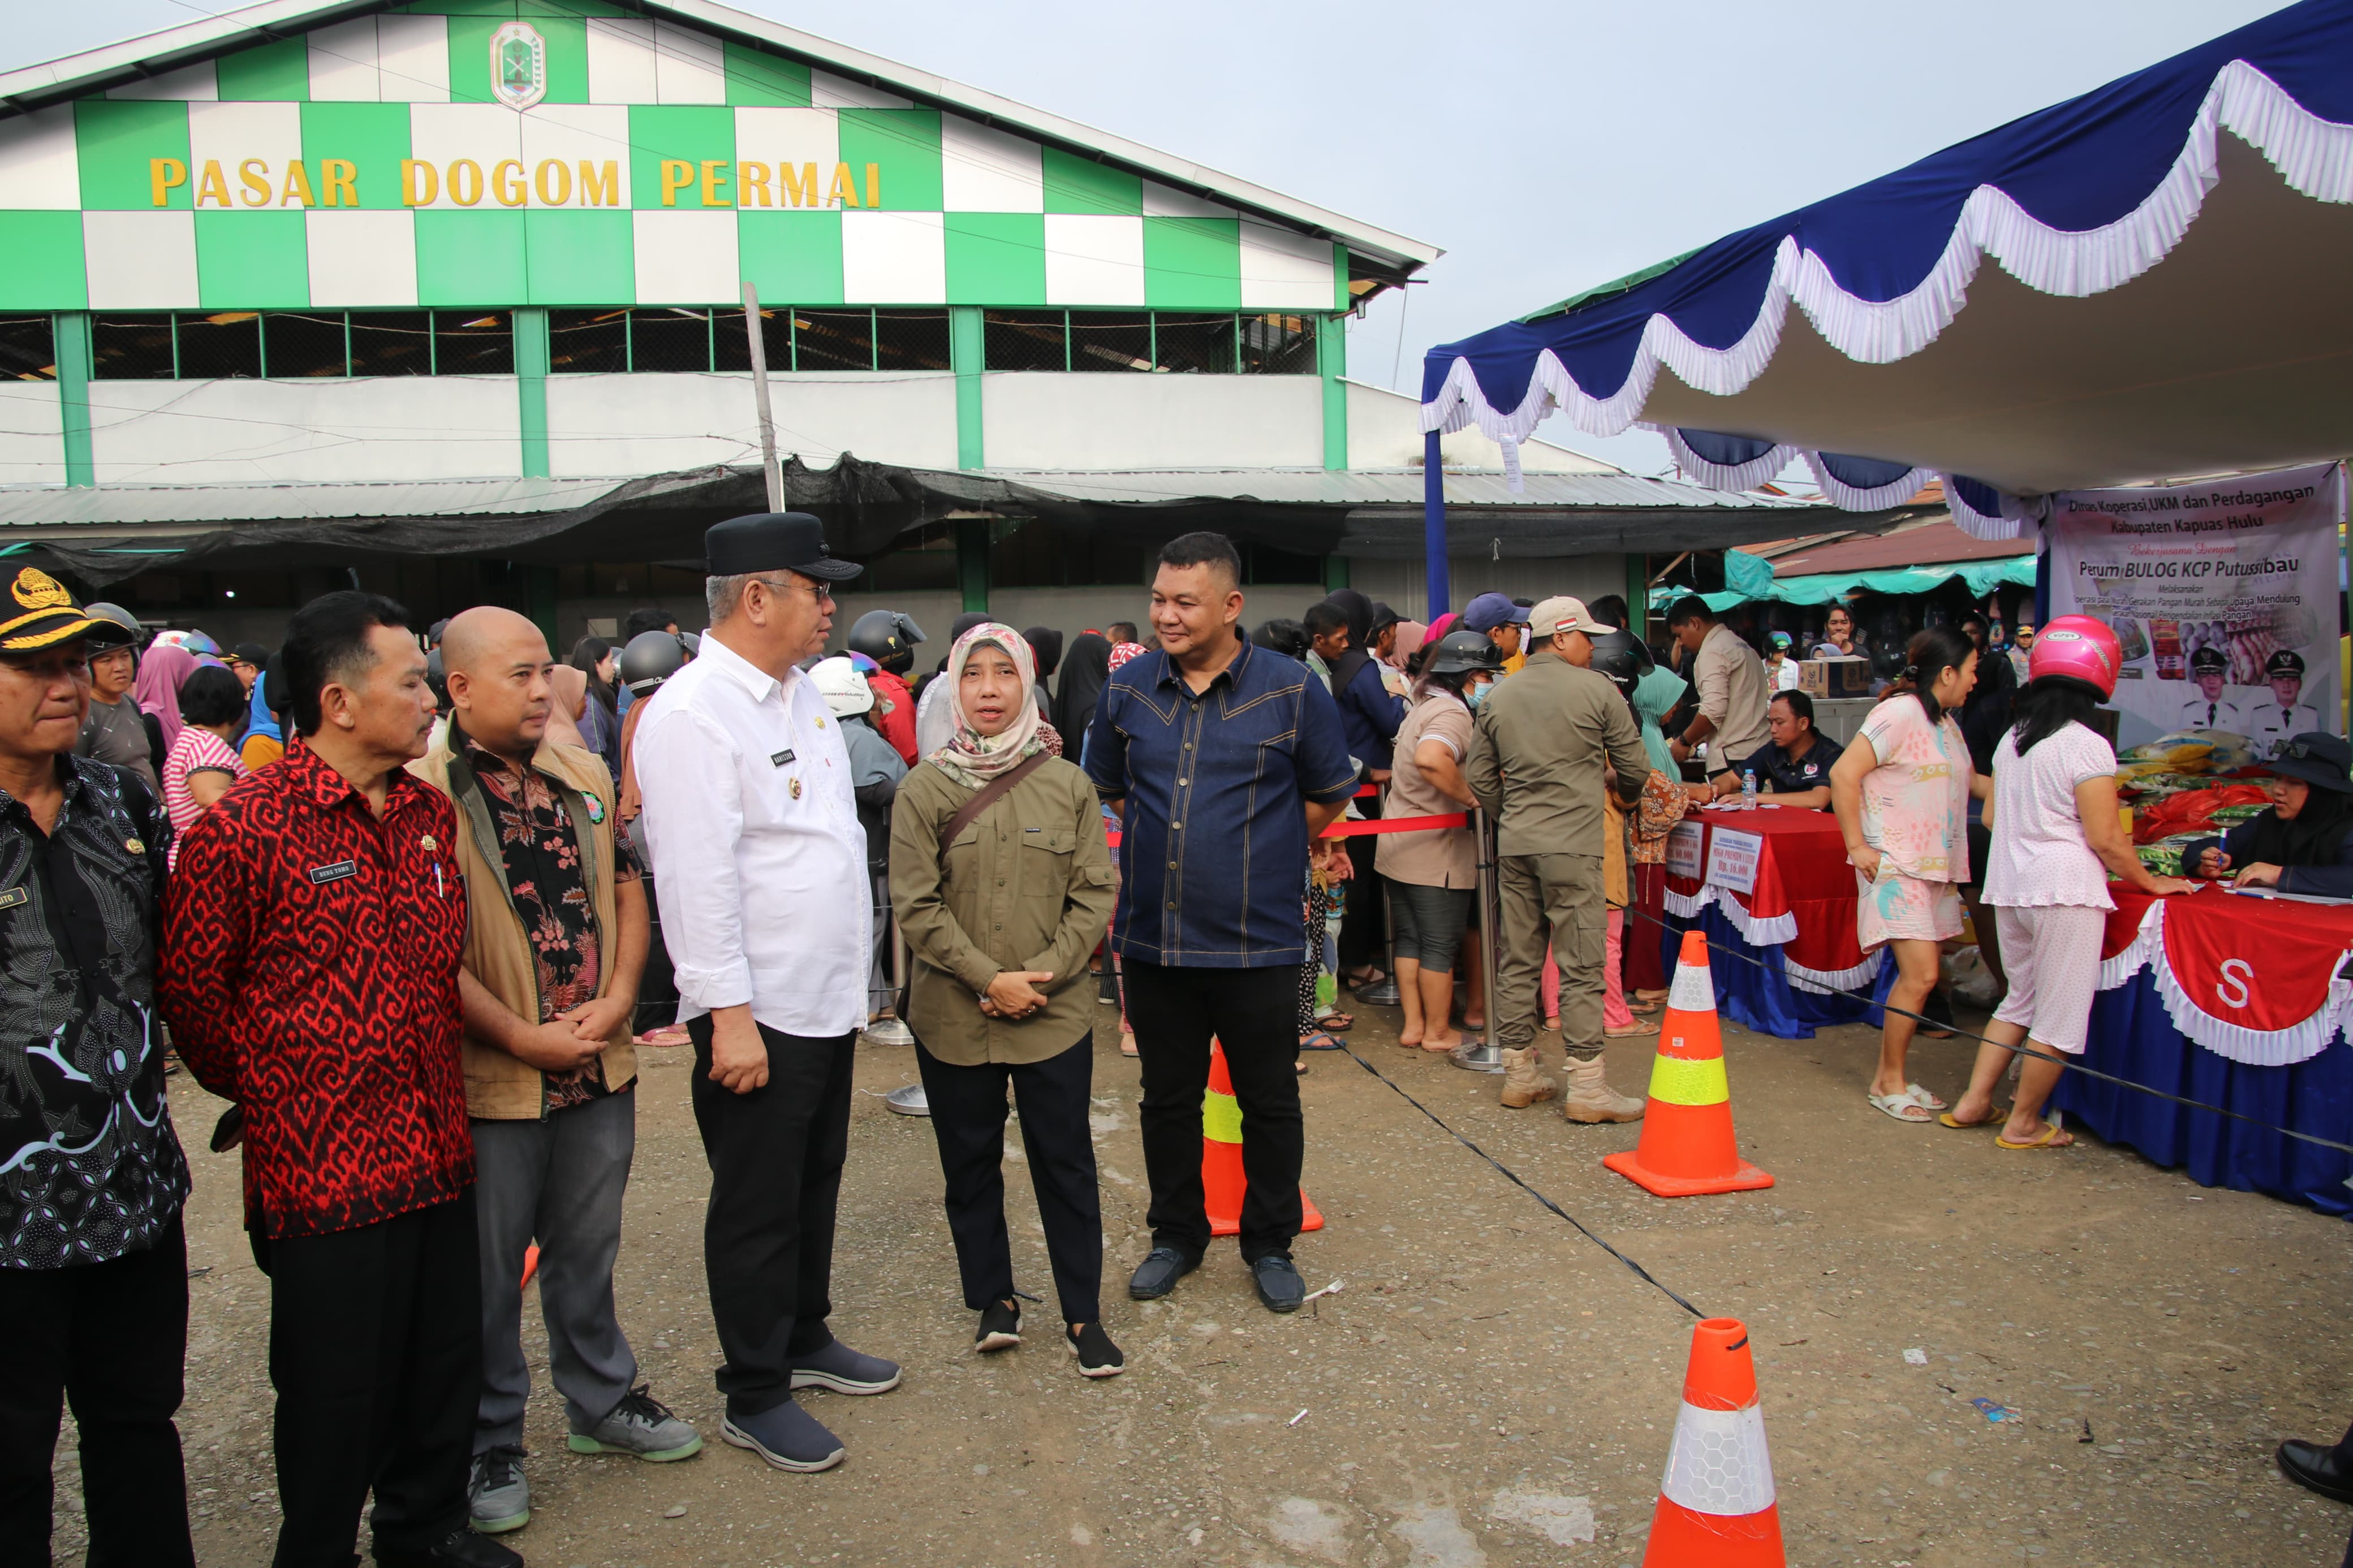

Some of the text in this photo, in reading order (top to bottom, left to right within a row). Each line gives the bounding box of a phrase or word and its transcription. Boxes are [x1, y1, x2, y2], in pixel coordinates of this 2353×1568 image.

[149, 157, 880, 208] PASAR DOGOM PERMAI
[2069, 500, 2098, 512] Dinas
[2183, 495, 2208, 509] dan
[2211, 486, 2314, 508] Perdagangan
[2111, 513, 2264, 536] Kabupaten Kapuas Hulu
[2195, 542, 2237, 558] Dengan
[2080, 556, 2299, 578] Perum BULOG KCP Putussibau
[2158, 584, 2204, 594] Melaksanakan
[2230, 597, 2254, 608] Upaya
[2257, 594, 2300, 606] Mendukung
[2222, 611, 2252, 621] Pangan
[774, 752, 794, 764] HARISSON
[1675, 849, 1693, 861] 60.000
[1718, 859, 1748, 877] Rp. 16.000
[2216, 958, 2254, 1009] S
